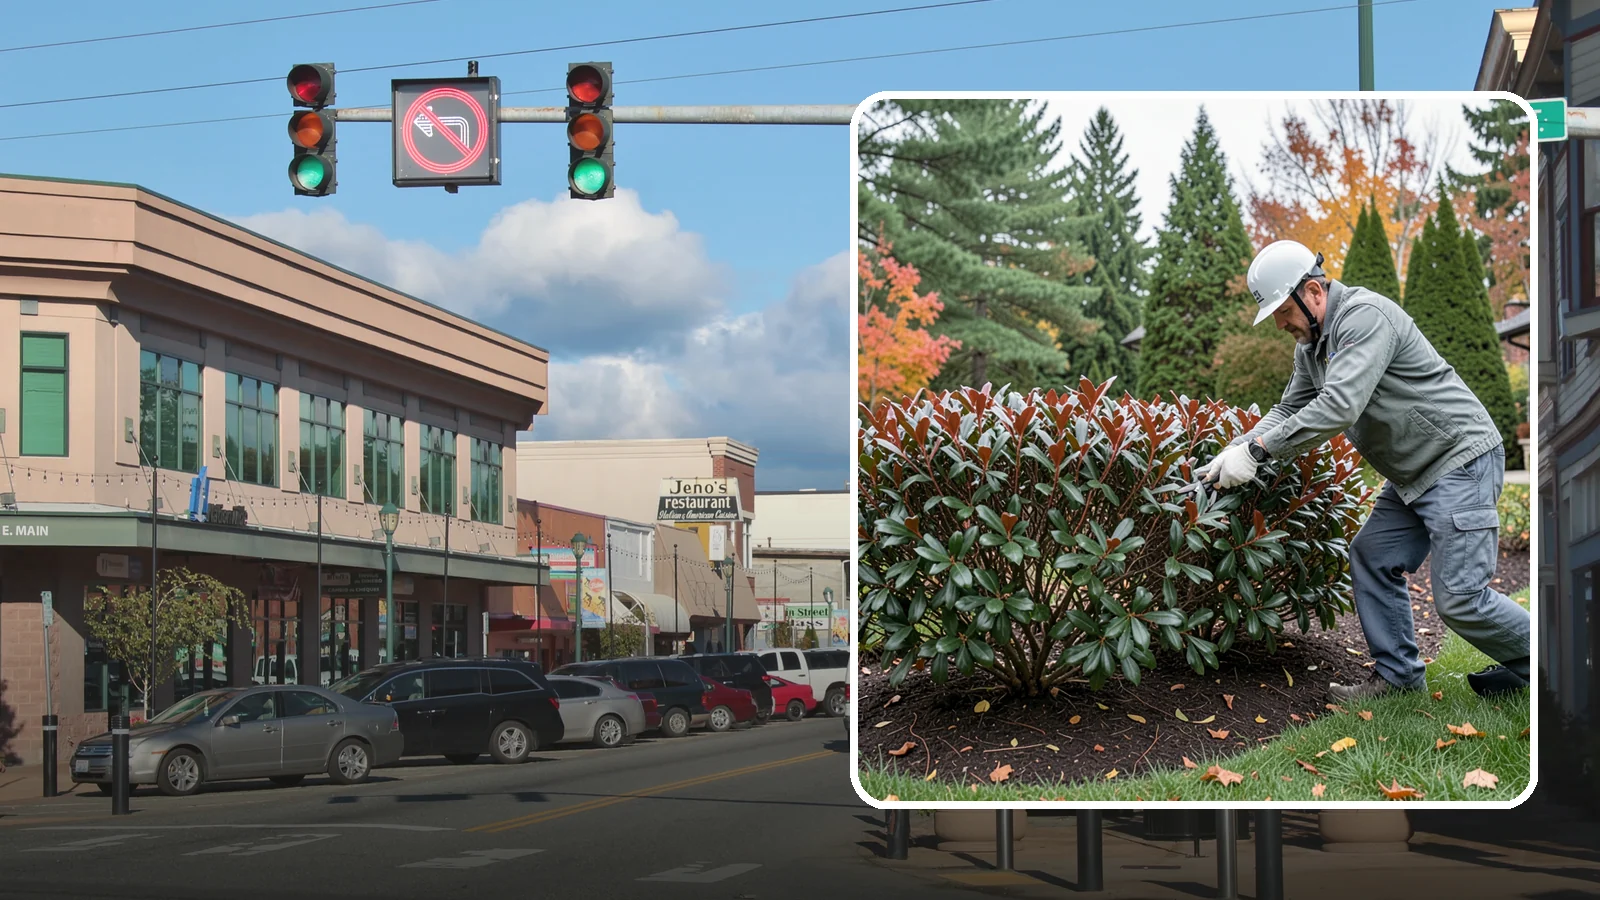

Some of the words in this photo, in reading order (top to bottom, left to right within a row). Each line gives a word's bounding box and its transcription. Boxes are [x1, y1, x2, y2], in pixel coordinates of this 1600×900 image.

[669, 480, 727, 494] Jeno's
[665, 496, 731, 509] restaurant
[658, 510, 682, 520] Italian
[686, 510, 715, 520] American
[715, 510, 737, 519] Cuisine
[2, 525, 13, 536] E.
[15, 525, 49, 536] MAIN
[797, 607, 828, 617] Street
